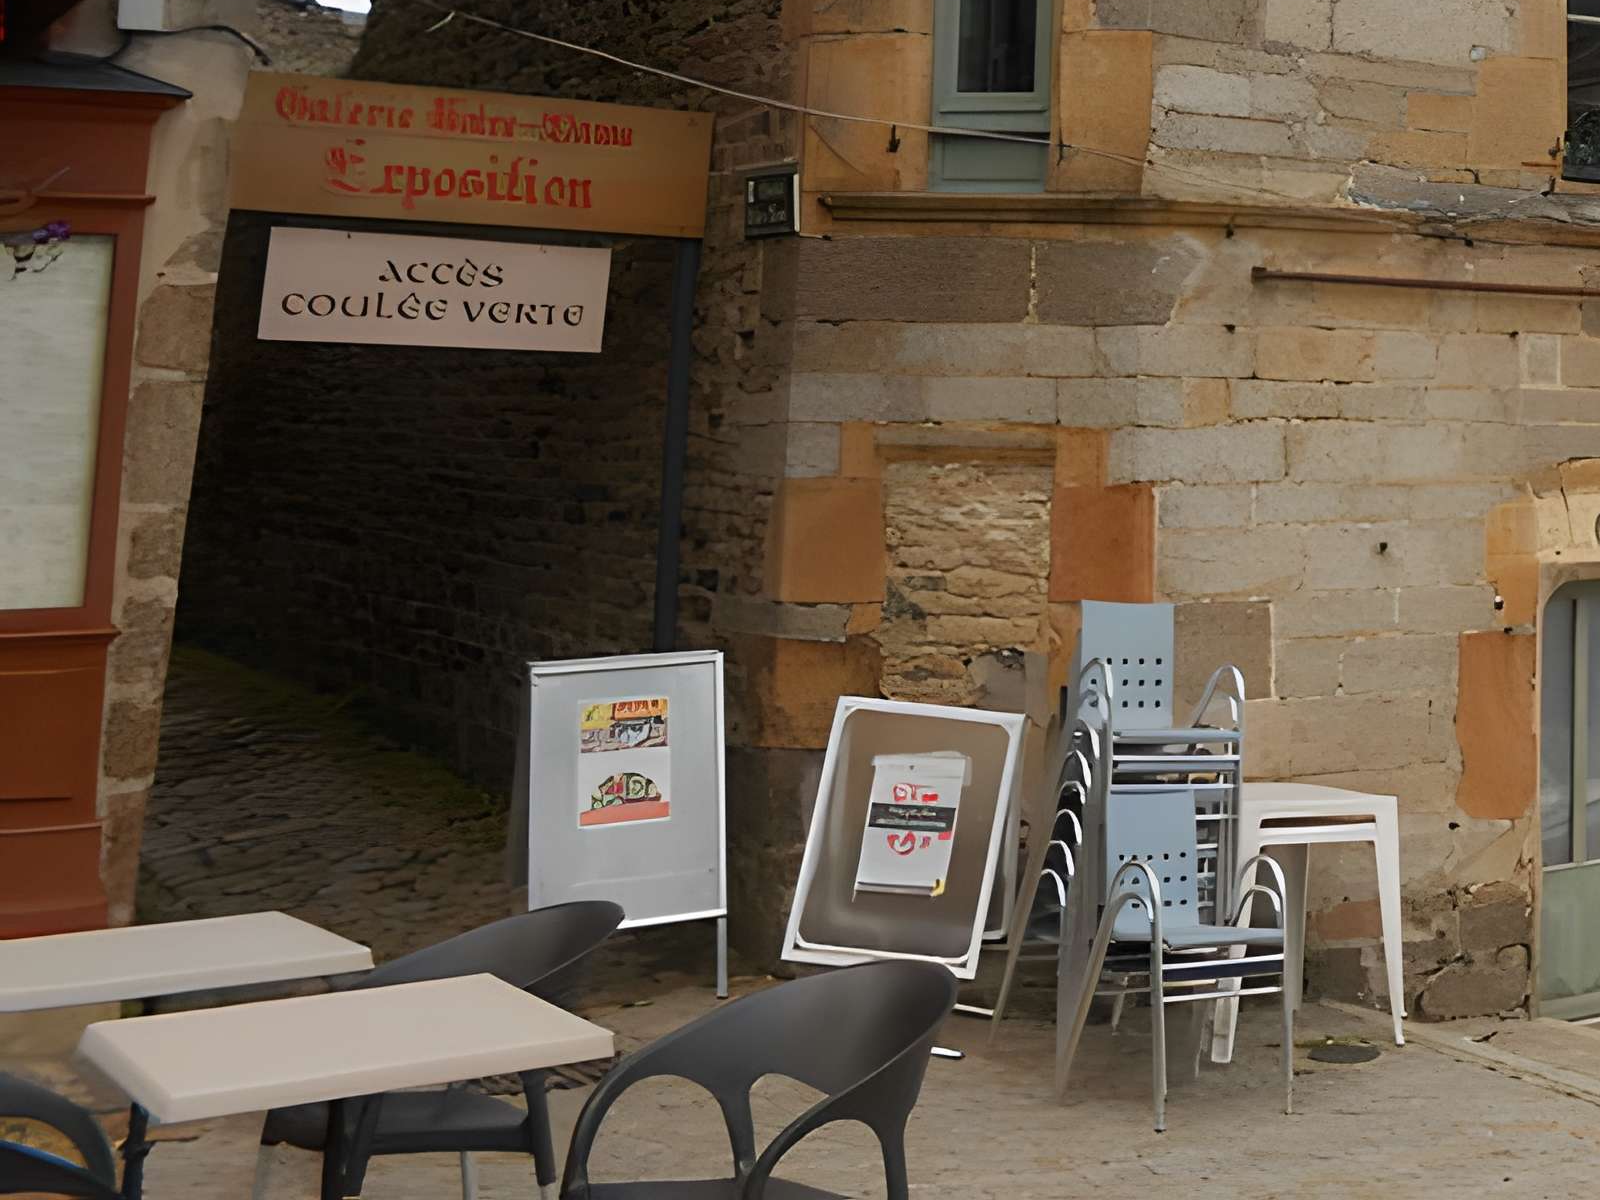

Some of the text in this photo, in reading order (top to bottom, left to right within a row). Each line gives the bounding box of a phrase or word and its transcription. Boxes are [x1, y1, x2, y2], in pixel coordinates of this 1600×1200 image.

[325, 138, 593, 210] Exposition
[378, 258, 504, 287] ACCÈS
[463, 300, 584, 327] VERTE
